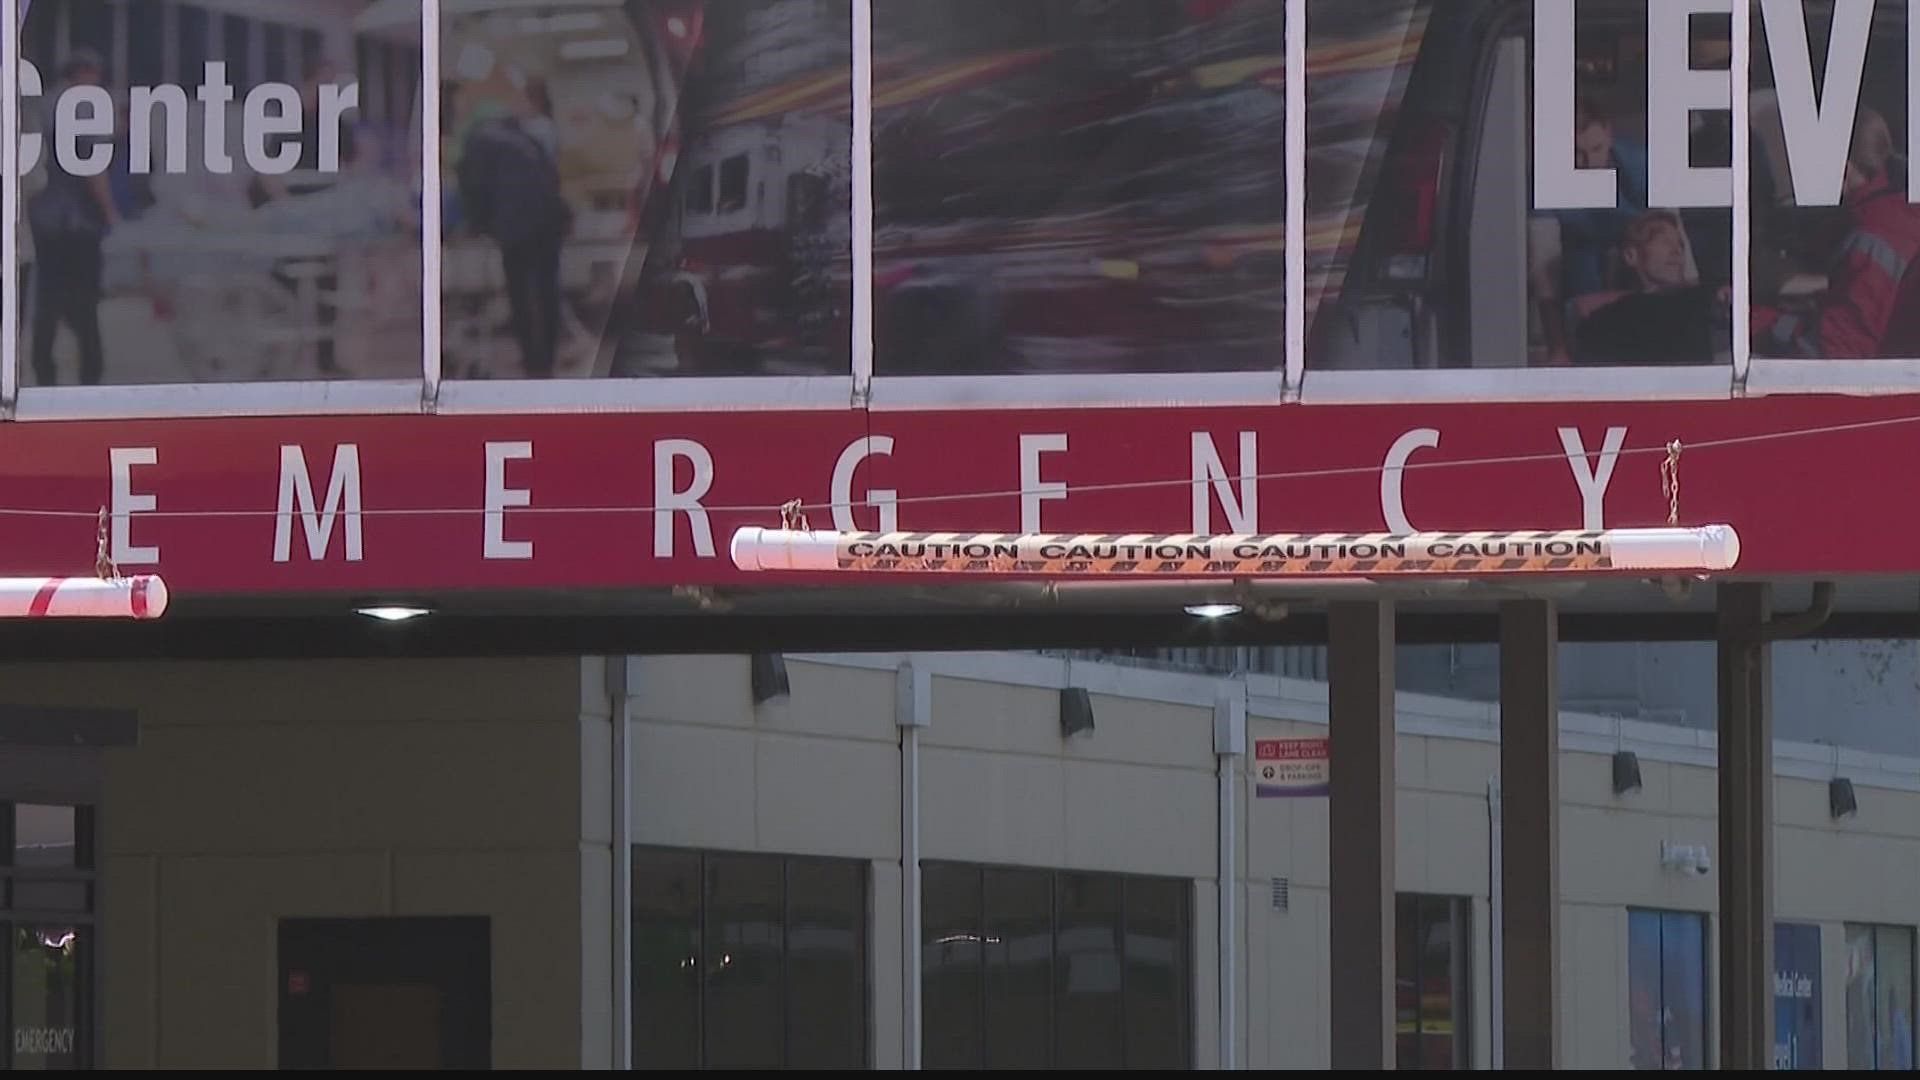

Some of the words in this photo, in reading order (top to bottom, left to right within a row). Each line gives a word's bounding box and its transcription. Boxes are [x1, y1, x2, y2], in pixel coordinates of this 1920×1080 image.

[1534, 0, 1920, 208] LEV
[109, 426, 1627, 564] EMERGENCY
[848, 543, 1018, 559] CAUTION
[1040, 544, 1211, 559] CAUTION
[1233, 543, 1404, 559] CAUTION
[1427, 541, 1600, 558] CAUTION
[1279, 742, 1300, 750] KEEP
[16, 1028, 74, 1053] EMERGENCY
